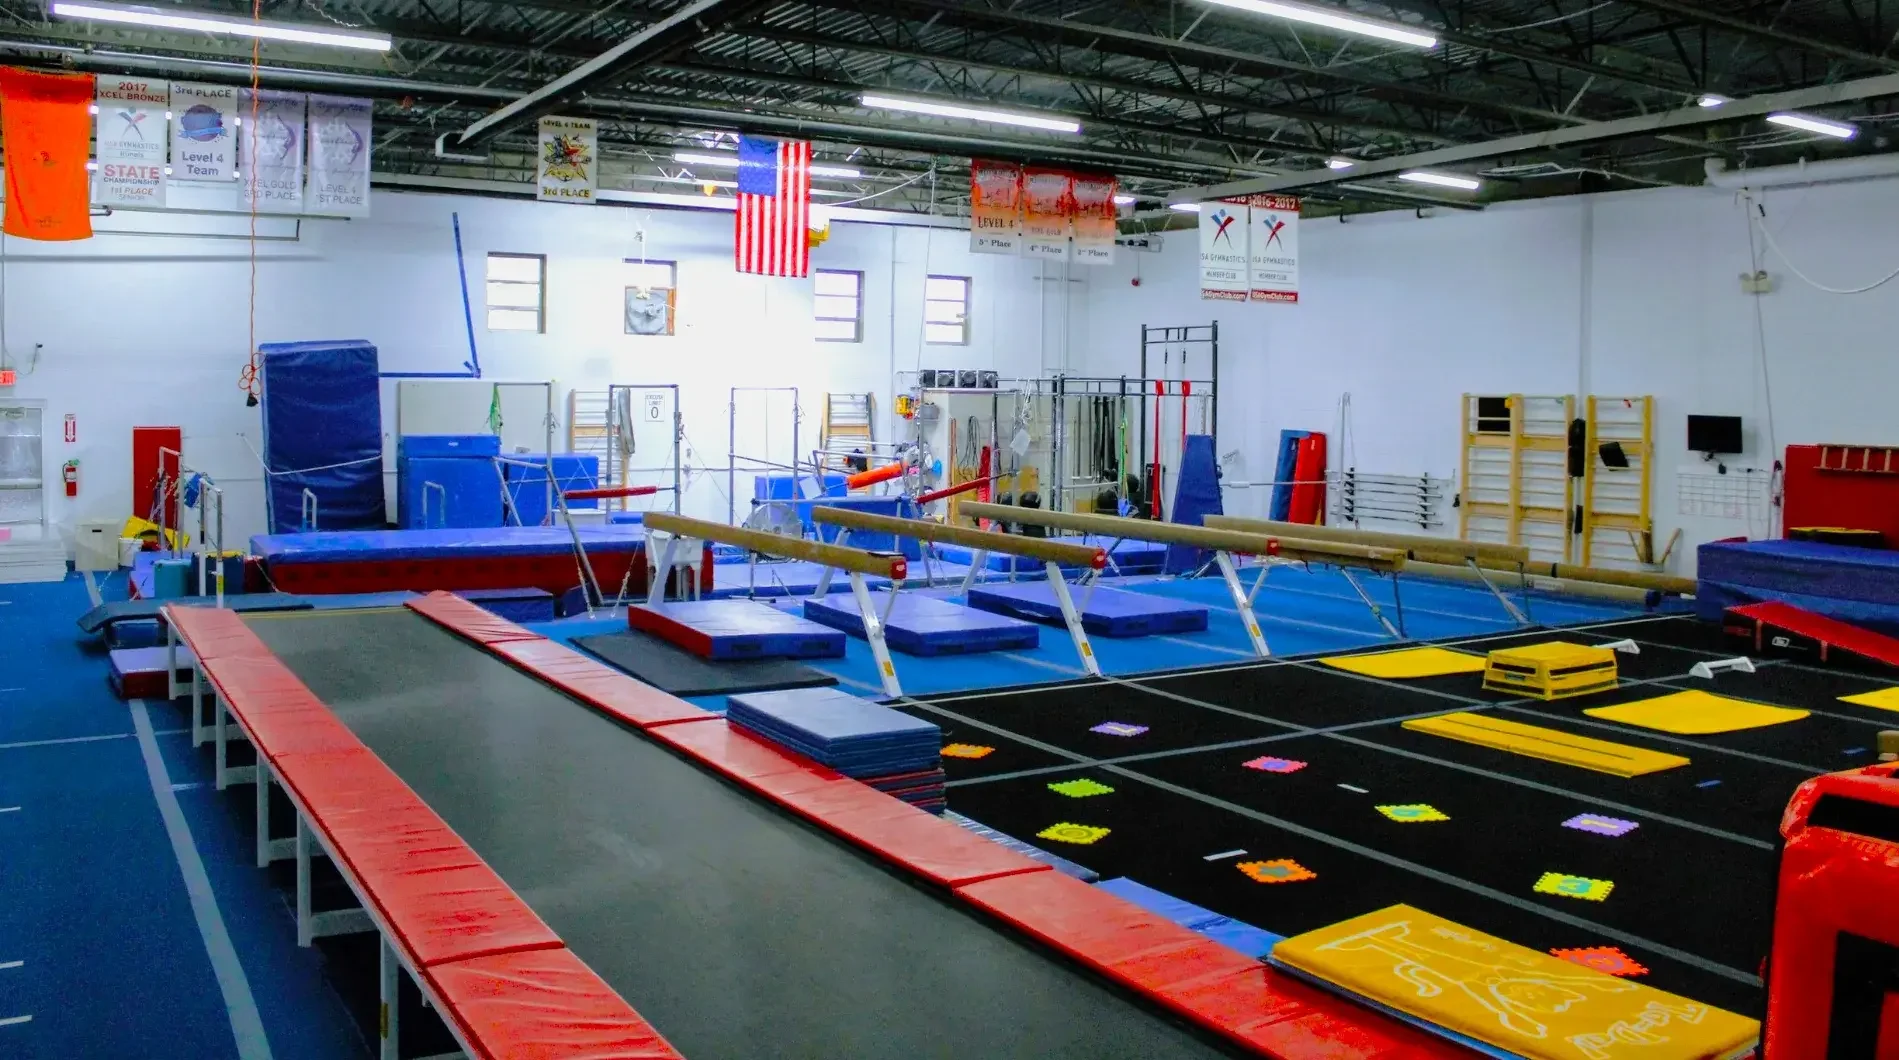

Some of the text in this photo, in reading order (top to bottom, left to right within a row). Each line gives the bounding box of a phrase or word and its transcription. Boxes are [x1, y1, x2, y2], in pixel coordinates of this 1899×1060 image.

[118, 82, 147, 92] 2017
[126, 93, 165, 103] BRONZE
[195, 89, 232, 98] PLACE
[182, 151, 224, 163] Level 4
[104, 164, 160, 180] STATE
[186, 164, 220, 176] Team
[103, 177, 160, 185] CHAMPIONSHIP
[270, 180, 297, 190] GOLD
[124, 187, 154, 196] PLACE
[265, 191, 296, 201] PLACE
[560, 188, 590, 198] PLACE
[333, 195, 363, 205] PLACE
[977, 216, 1015, 229] LEVEL 4
[991, 239, 1012, 248] Place
[1041, 245, 1063, 254] Place
[1088, 249, 1109, 258] Place
[1210, 254, 1246, 263] GYMNASTICS
[651, 406, 659, 419] 0
